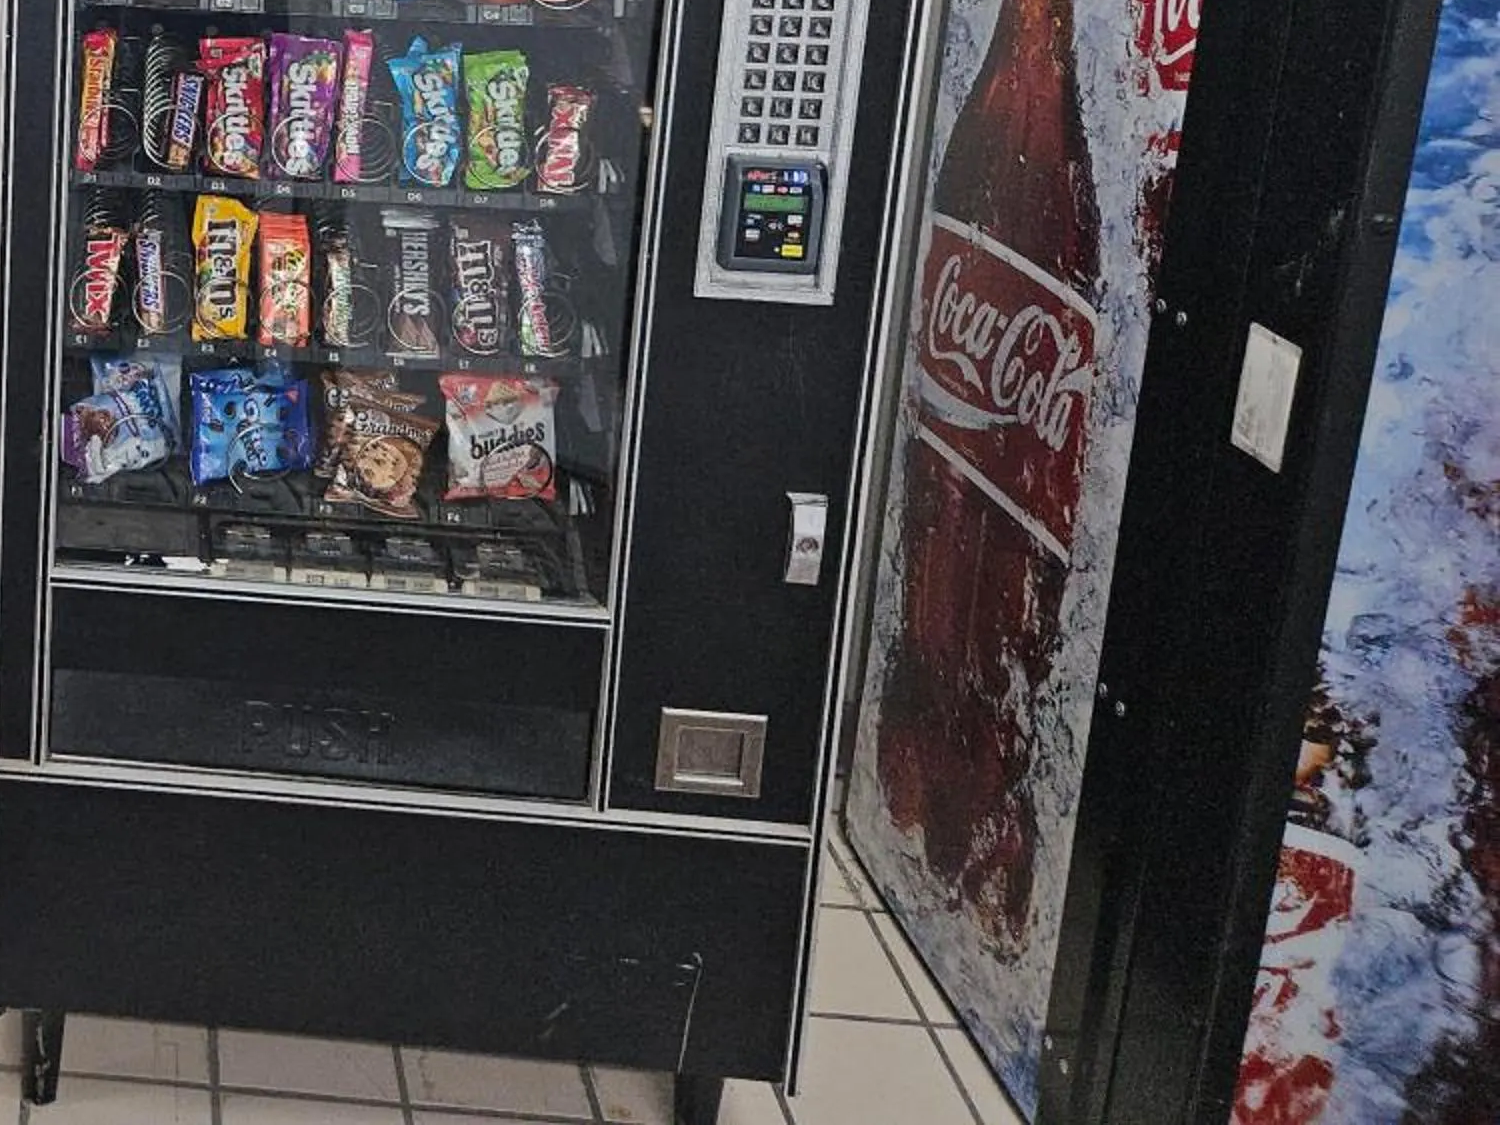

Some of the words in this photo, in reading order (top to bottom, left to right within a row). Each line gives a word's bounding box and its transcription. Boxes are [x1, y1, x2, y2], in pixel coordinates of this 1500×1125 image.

[172, 75, 200, 144] SNICKERS
[221, 65, 248, 167] Skittles
[286, 61, 318, 175] Skittles
[413, 72, 460, 171] Skittles
[147, 176, 161, 186] D2
[85, 233, 113, 315] TWIX
[401, 230, 430, 316] HERSHEY'S
[928, 254, 1095, 453] Coca-Cola
[471, 423, 545, 461] buddies
